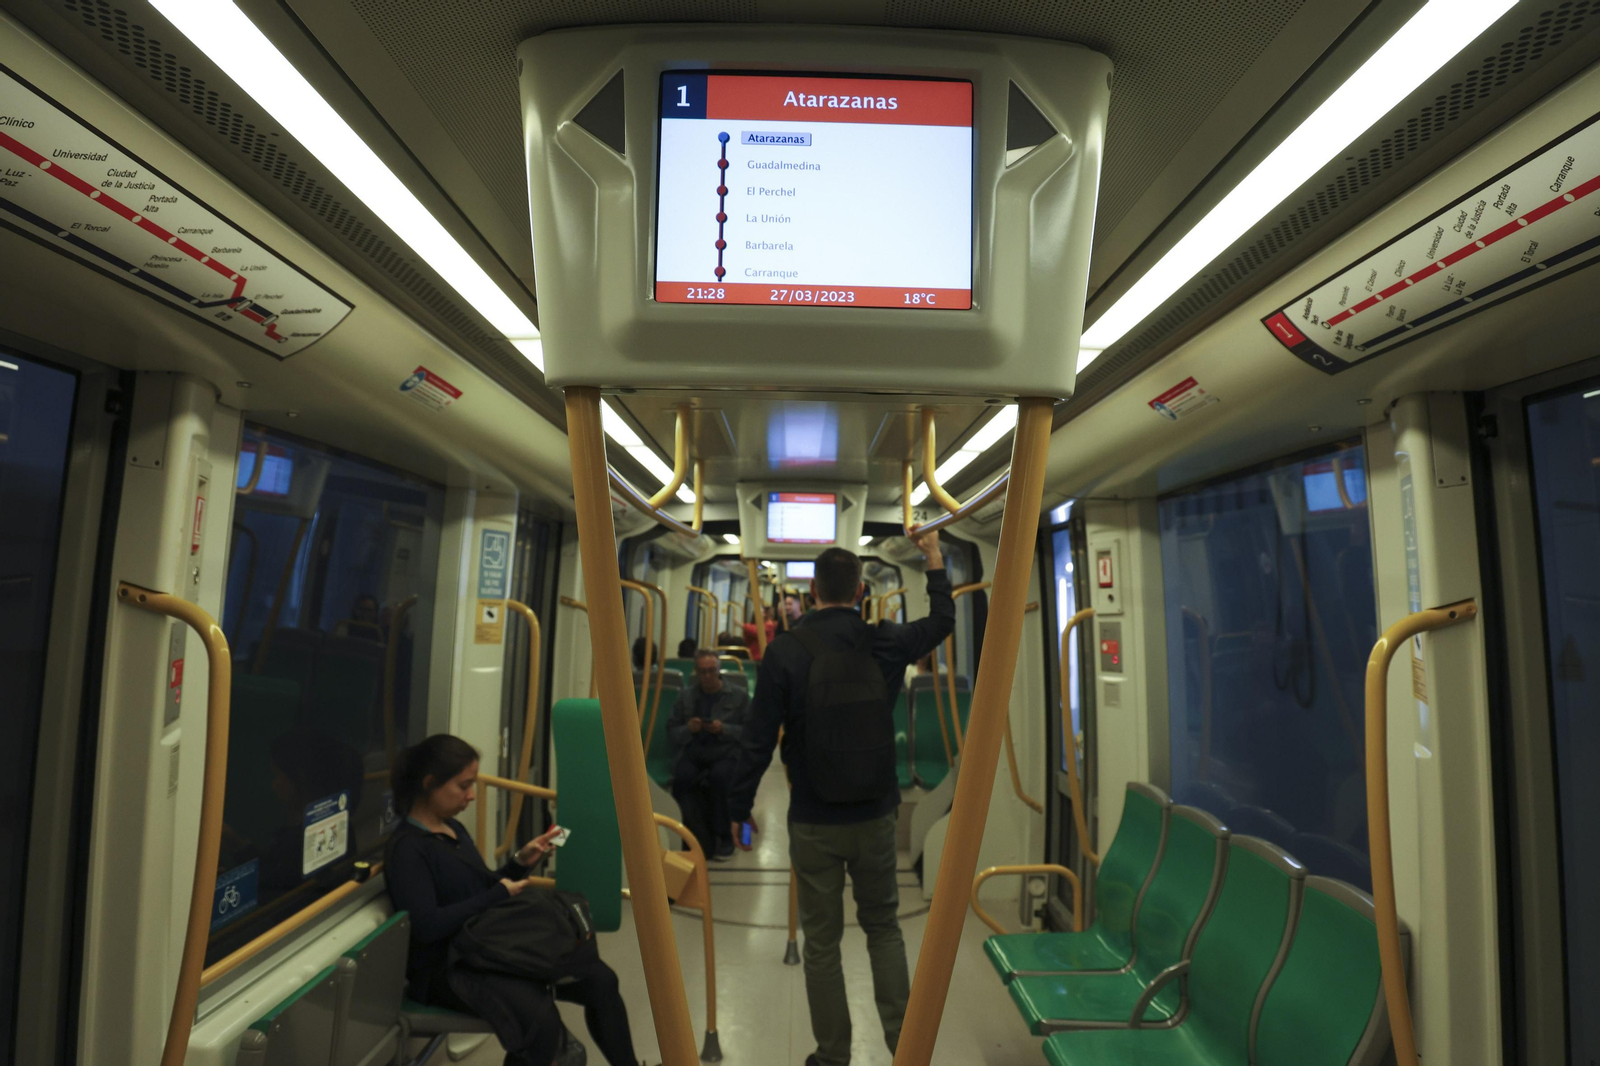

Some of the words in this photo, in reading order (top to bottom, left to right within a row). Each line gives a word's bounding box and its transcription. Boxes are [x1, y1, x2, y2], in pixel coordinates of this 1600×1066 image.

[676, 85, 691, 107] 1
[783, 91, 898, 110] Atarazanas
[747, 133, 805, 144] Atarazanas
[52, 149, 108, 162] Universidad
[747, 160, 821, 171] Guadalmedina
[5, 168, 26, 178] Luz
[106, 168, 138, 178] Ciudad
[1550, 156, 1575, 192] Carranque
[124, 180, 156, 190] Justicia
[746, 187, 756, 196] El
[758, 187, 796, 197] Perchel
[1492, 184, 1511, 210] Portada
[148, 194, 178, 204] Portada
[142, 205, 160, 213] Alta
[1505, 202, 1518, 217] Alta
[746, 214, 758, 222] La
[760, 213, 791, 224] Unión
[1453, 210, 1468, 232] Ciudad
[84, 224, 111, 232] Torcal
[177, 226, 214, 236] Carranque
[746, 240, 794, 251] Barbarela
[1426, 226, 1444, 260] Universidad
[1524, 240, 1539, 256] Torcal
[744, 268, 799, 279] Carranque
[686, 288, 726, 300] 21:28
[770, 290, 855, 303] 27/03/2023
[904, 293, 936, 305] 18°C
[1276, 322, 1294, 338] 1
[1312, 354, 1334, 366] 2
